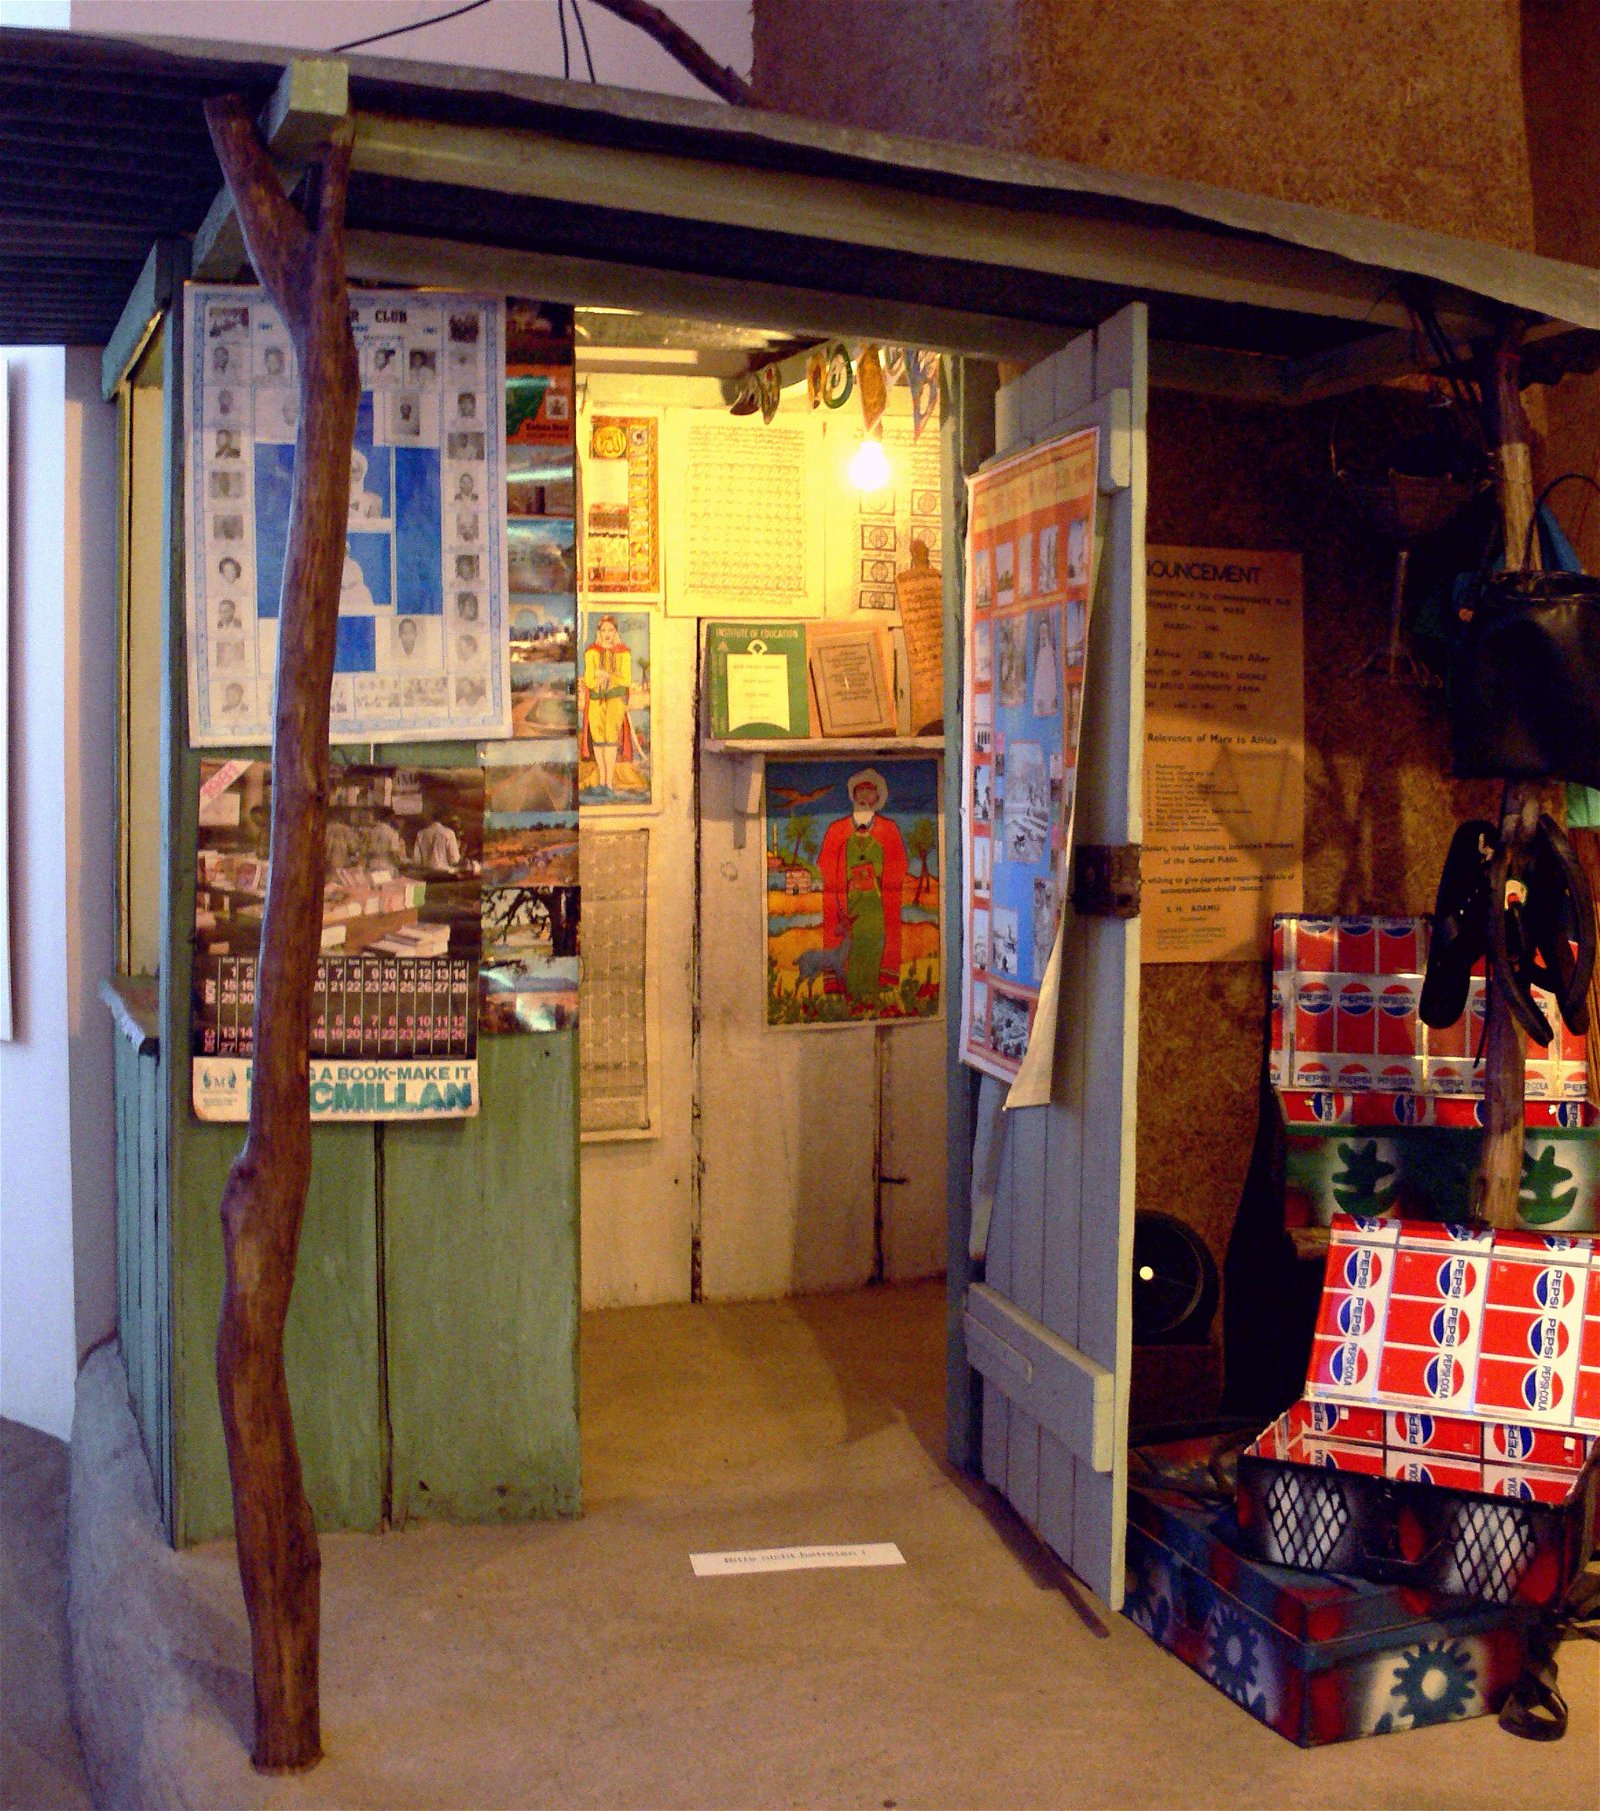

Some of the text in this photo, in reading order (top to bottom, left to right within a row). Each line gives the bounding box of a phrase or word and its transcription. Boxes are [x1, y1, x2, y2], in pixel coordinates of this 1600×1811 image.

[375, 309, 407, 323] CLUB
[715, 626, 799, 641] INSTITUTE OF EDUCATION
[231, 966, 236, 978] 1
[335, 968, 344, 979] 7
[384, 968, 397, 980] 10
[403, 968, 415, 980] 11
[419, 968, 432, 980] 12
[436, 968, 449, 980] 13
[453, 968, 466, 980] 14
[331, 981, 344, 992] 21
[347, 980, 361, 992] 22
[365, 981, 379, 992] 23
[382, 981, 396, 993] 24
[400, 981, 414, 993] 25
[418, 981, 432, 993] 26
[435, 981, 449, 993] 27
[453, 981, 467, 993] 28
[1298, 992, 1333, 1002] PEPSI
[1339, 993, 1375, 1003] PEPSI
[317, 1014, 325, 1026] 4
[418, 1014, 431, 1027] 10
[436, 1015, 448, 1027] 11
[453, 1015, 466, 1027] 12
[347, 1027, 361, 1040] 20
[365, 1028, 378, 1040] 21
[381, 1028, 395, 1041] 22
[416, 1028, 431, 1041] 24
[434, 1028, 448, 1041] 25
[321, 1067, 334, 1080] A
[337, 1066, 450, 1081] BOOK-MAKE
[454, 1066, 472, 1080] IT
[1297, 1073, 1331, 1083] PEPSI
[1338, 1075, 1372, 1085] PEPSI
[310, 1081, 473, 1113] CMILLAN
[1358, 1249, 1372, 1290] PEPSI
[1450, 1258, 1465, 1299] PEPSI
[1549, 1269, 1563, 1310] PEPSI
[1351, 1297, 1365, 1337] PEPSI
[1445, 1306, 1459, 1348] PEPSI
[1543, 1317, 1557, 1359] PEPSI
[1343, 1342, 1358, 1386] PEPSI-COLA
[1439, 1353, 1453, 1399] PEPSI-COLA
[1537, 1365, 1552, 1412] PEPSI-COLA
[1507, 1424, 1519, 1459] PEPS
